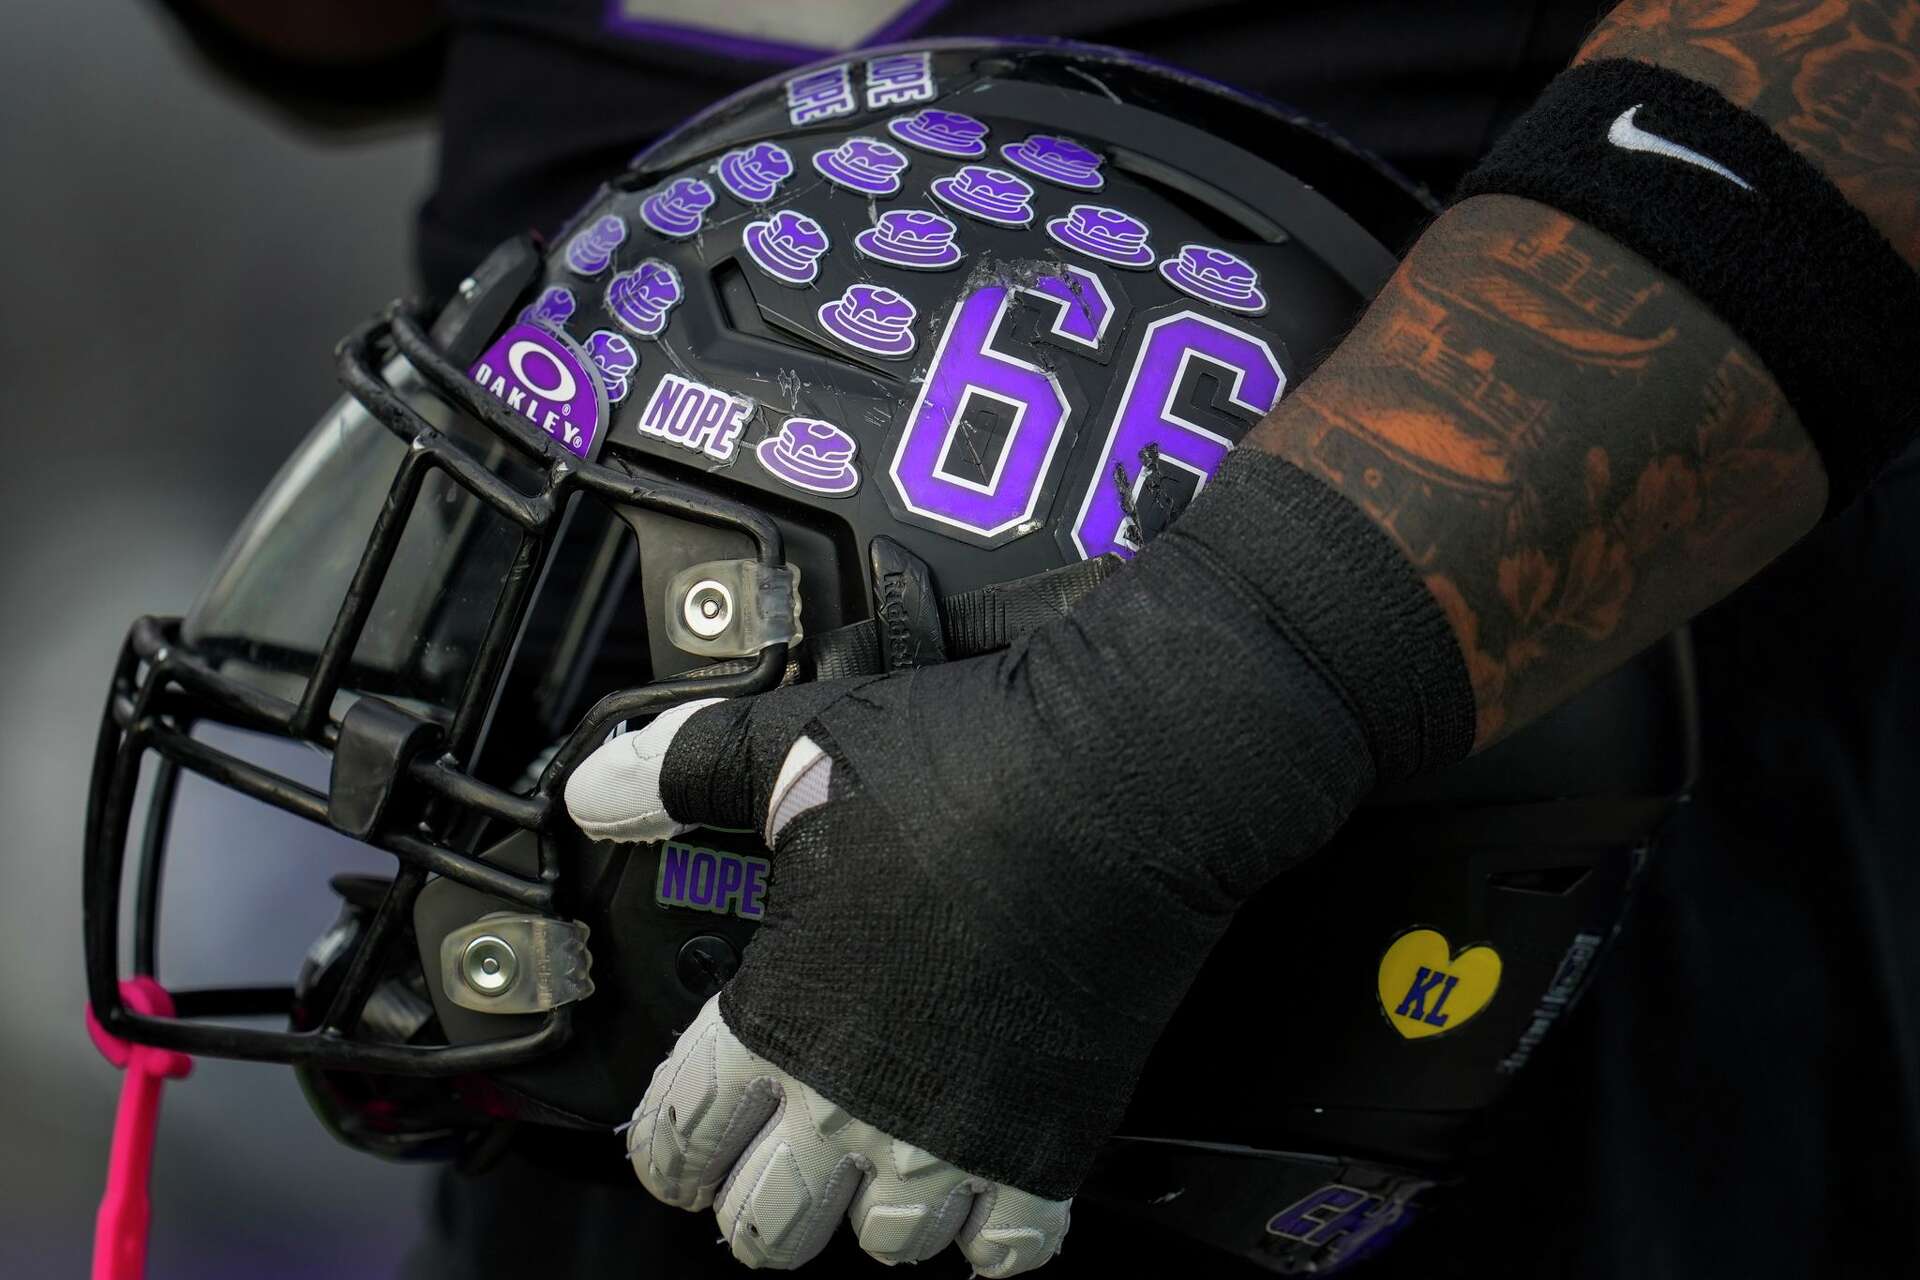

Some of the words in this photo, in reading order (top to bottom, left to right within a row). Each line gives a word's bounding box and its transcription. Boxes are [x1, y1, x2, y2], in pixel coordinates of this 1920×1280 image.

[644, 378, 749, 455] NOPE
[889, 263, 1287, 561] 66
[662, 846, 768, 917] NOPE
[1394, 966, 1460, 1028] KL
